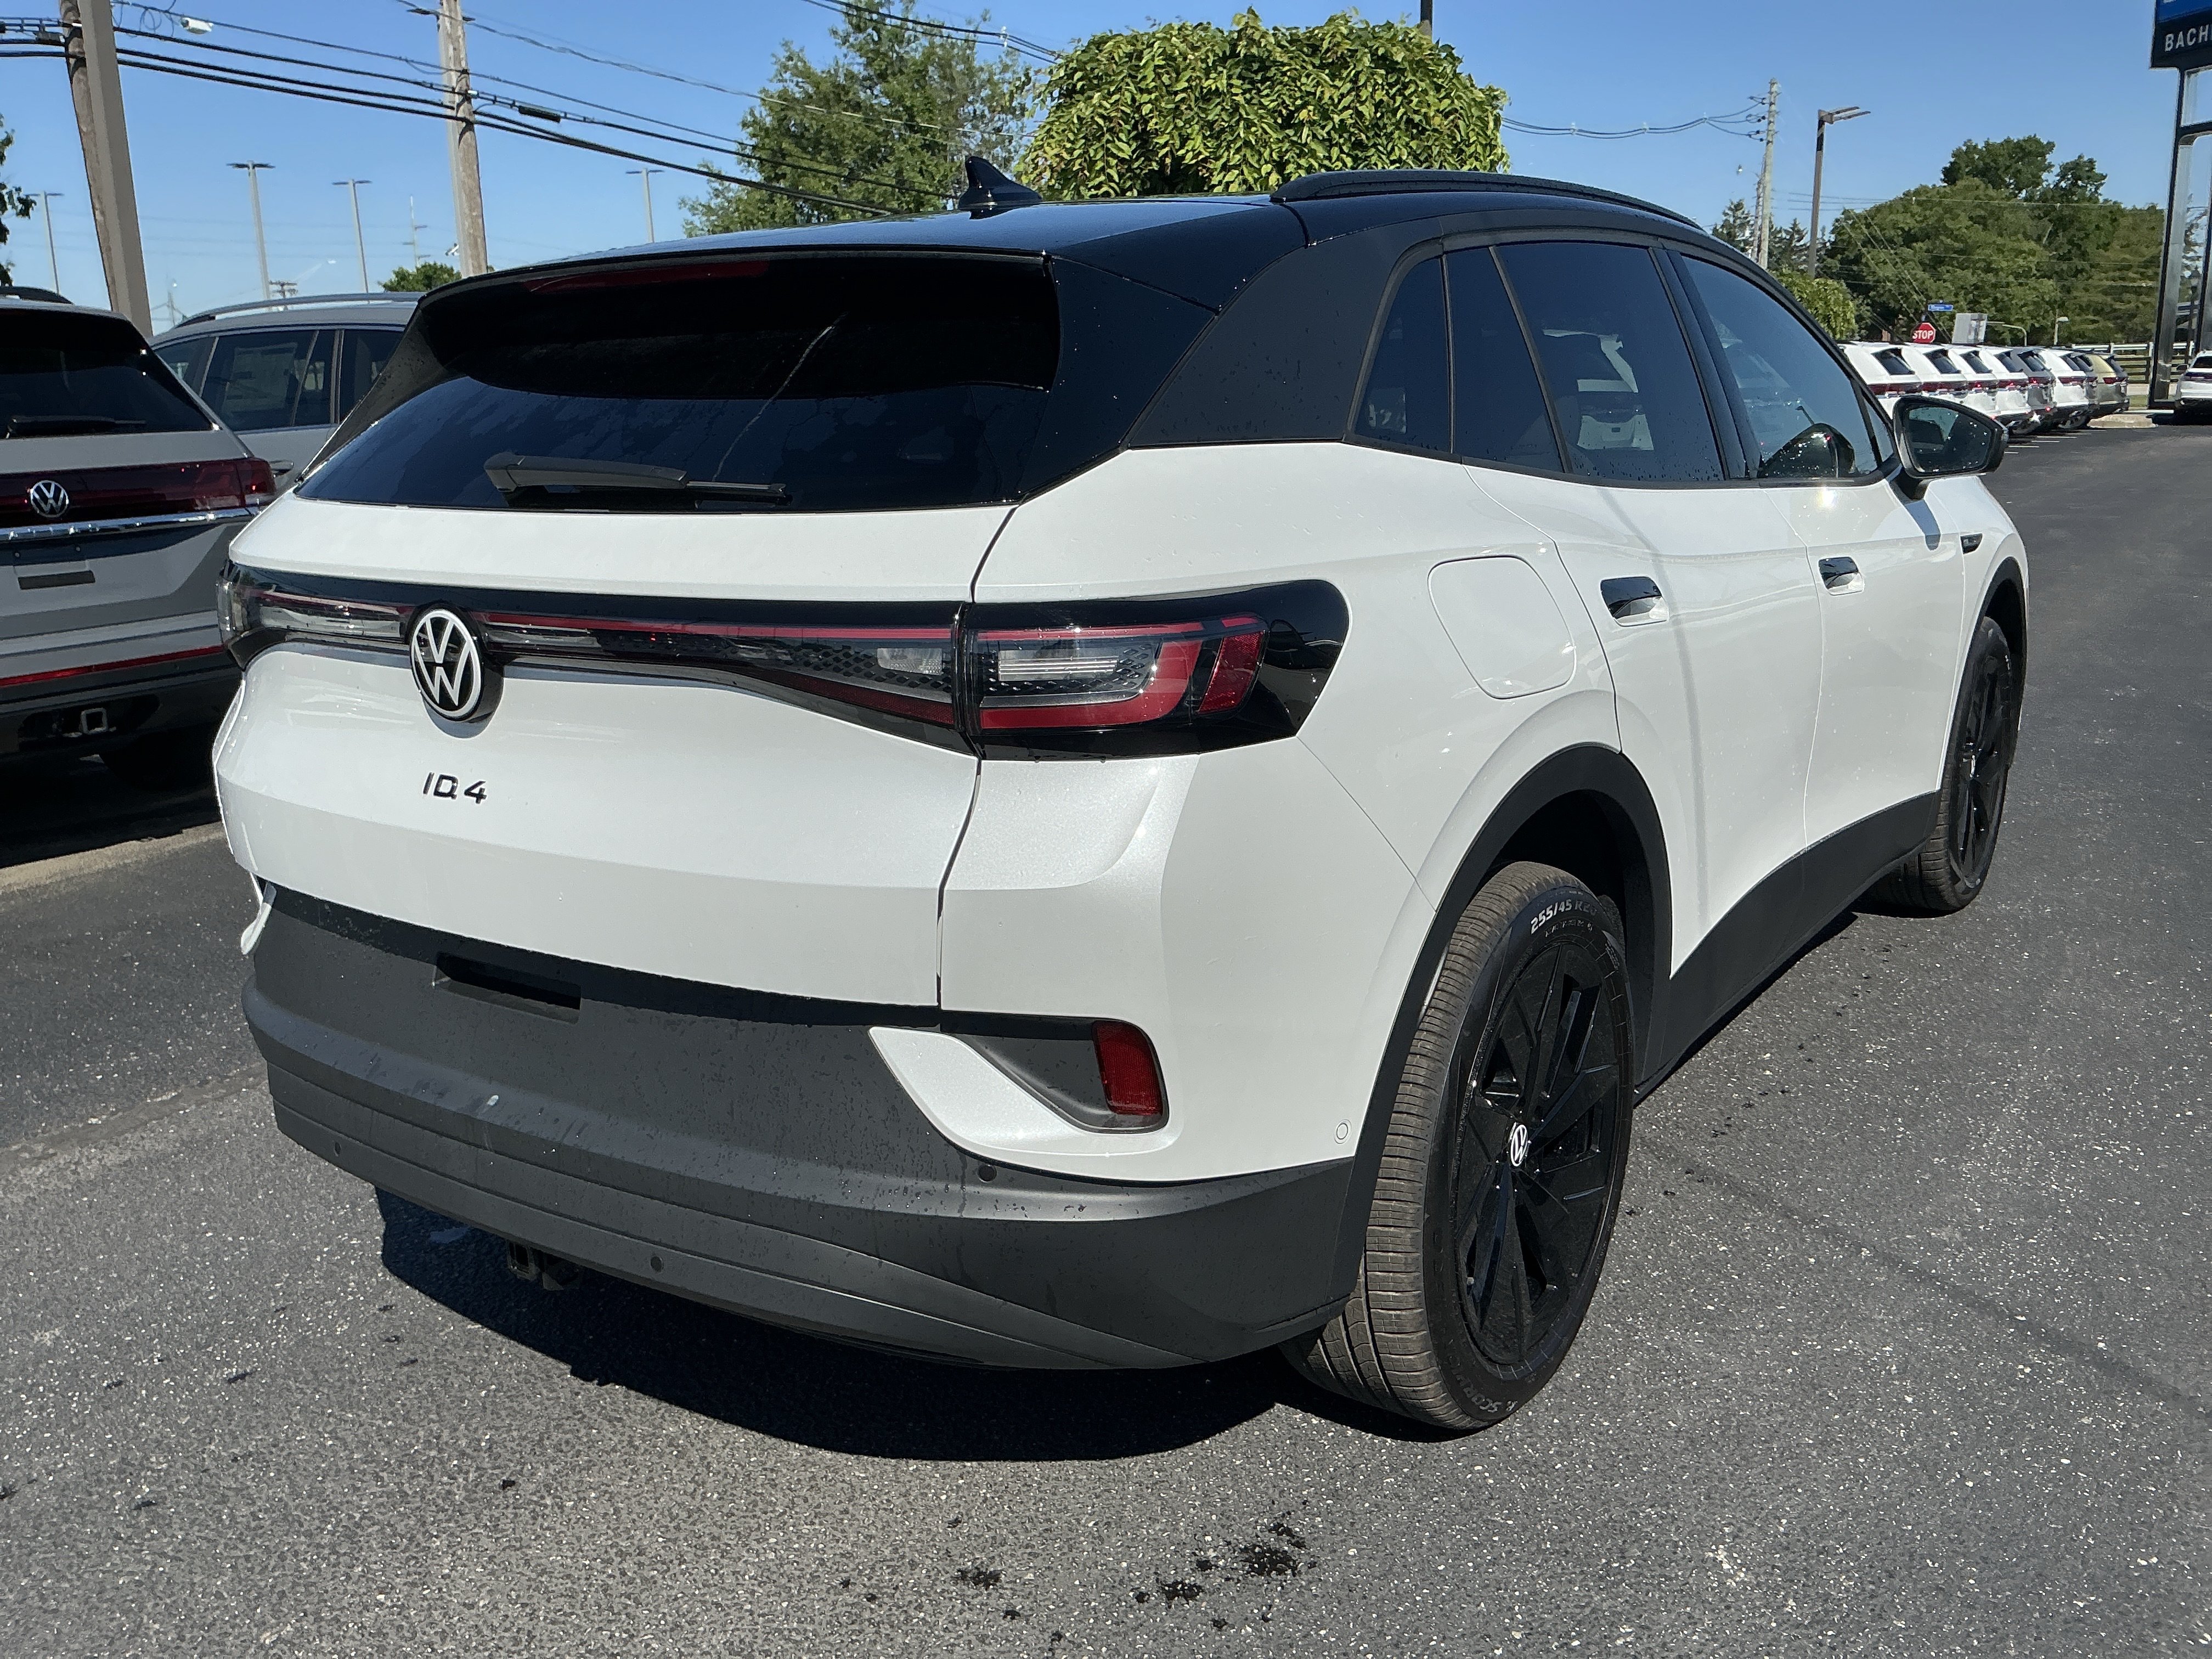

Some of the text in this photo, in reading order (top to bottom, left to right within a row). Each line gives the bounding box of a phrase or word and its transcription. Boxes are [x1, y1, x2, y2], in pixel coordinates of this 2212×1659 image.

[1912, 330, 1934, 340] STOP
[30, 480, 69, 517] VW
[411, 609, 481, 718] VW
[1530, 899, 1572, 935] 255/45
